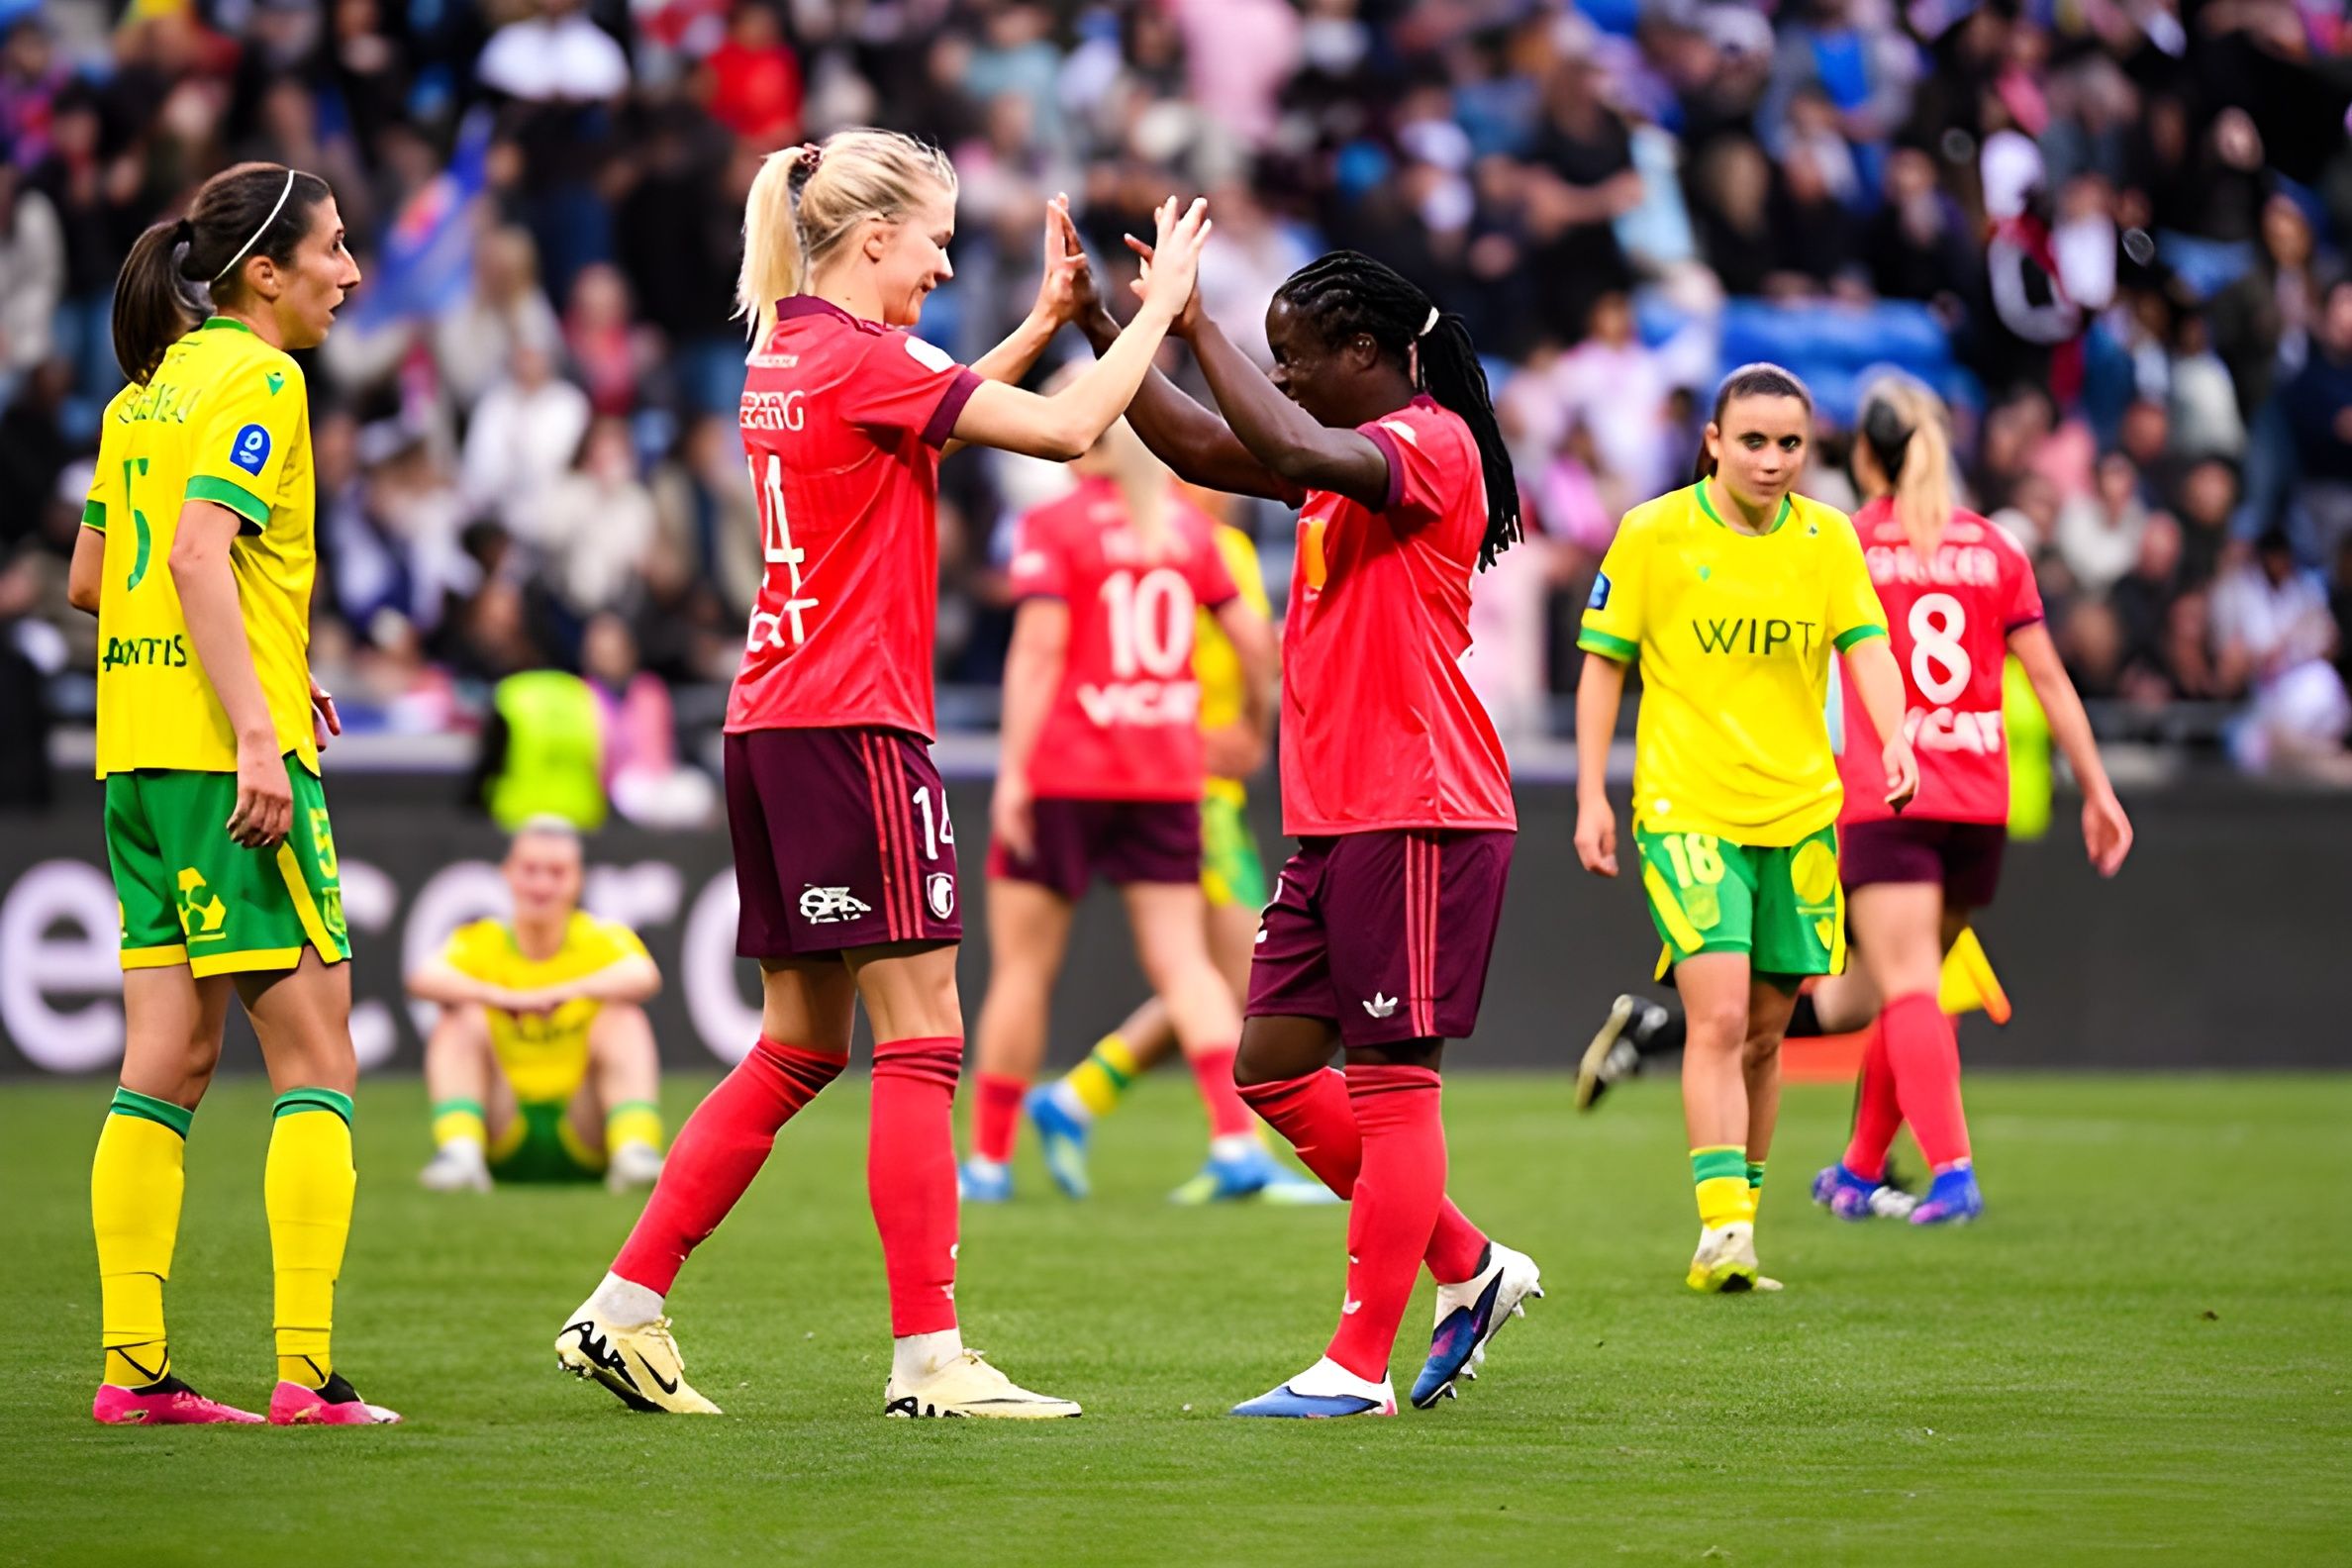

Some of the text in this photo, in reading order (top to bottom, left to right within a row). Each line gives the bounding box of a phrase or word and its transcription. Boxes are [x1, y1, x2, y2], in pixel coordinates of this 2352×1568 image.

[123, 457, 151, 592] 5
[1098, 568, 1196, 677] 10
[1692, 618, 1816, 655] WIPT
[1908, 593, 1972, 705] 8
[1663, 833, 1725, 888] 18
